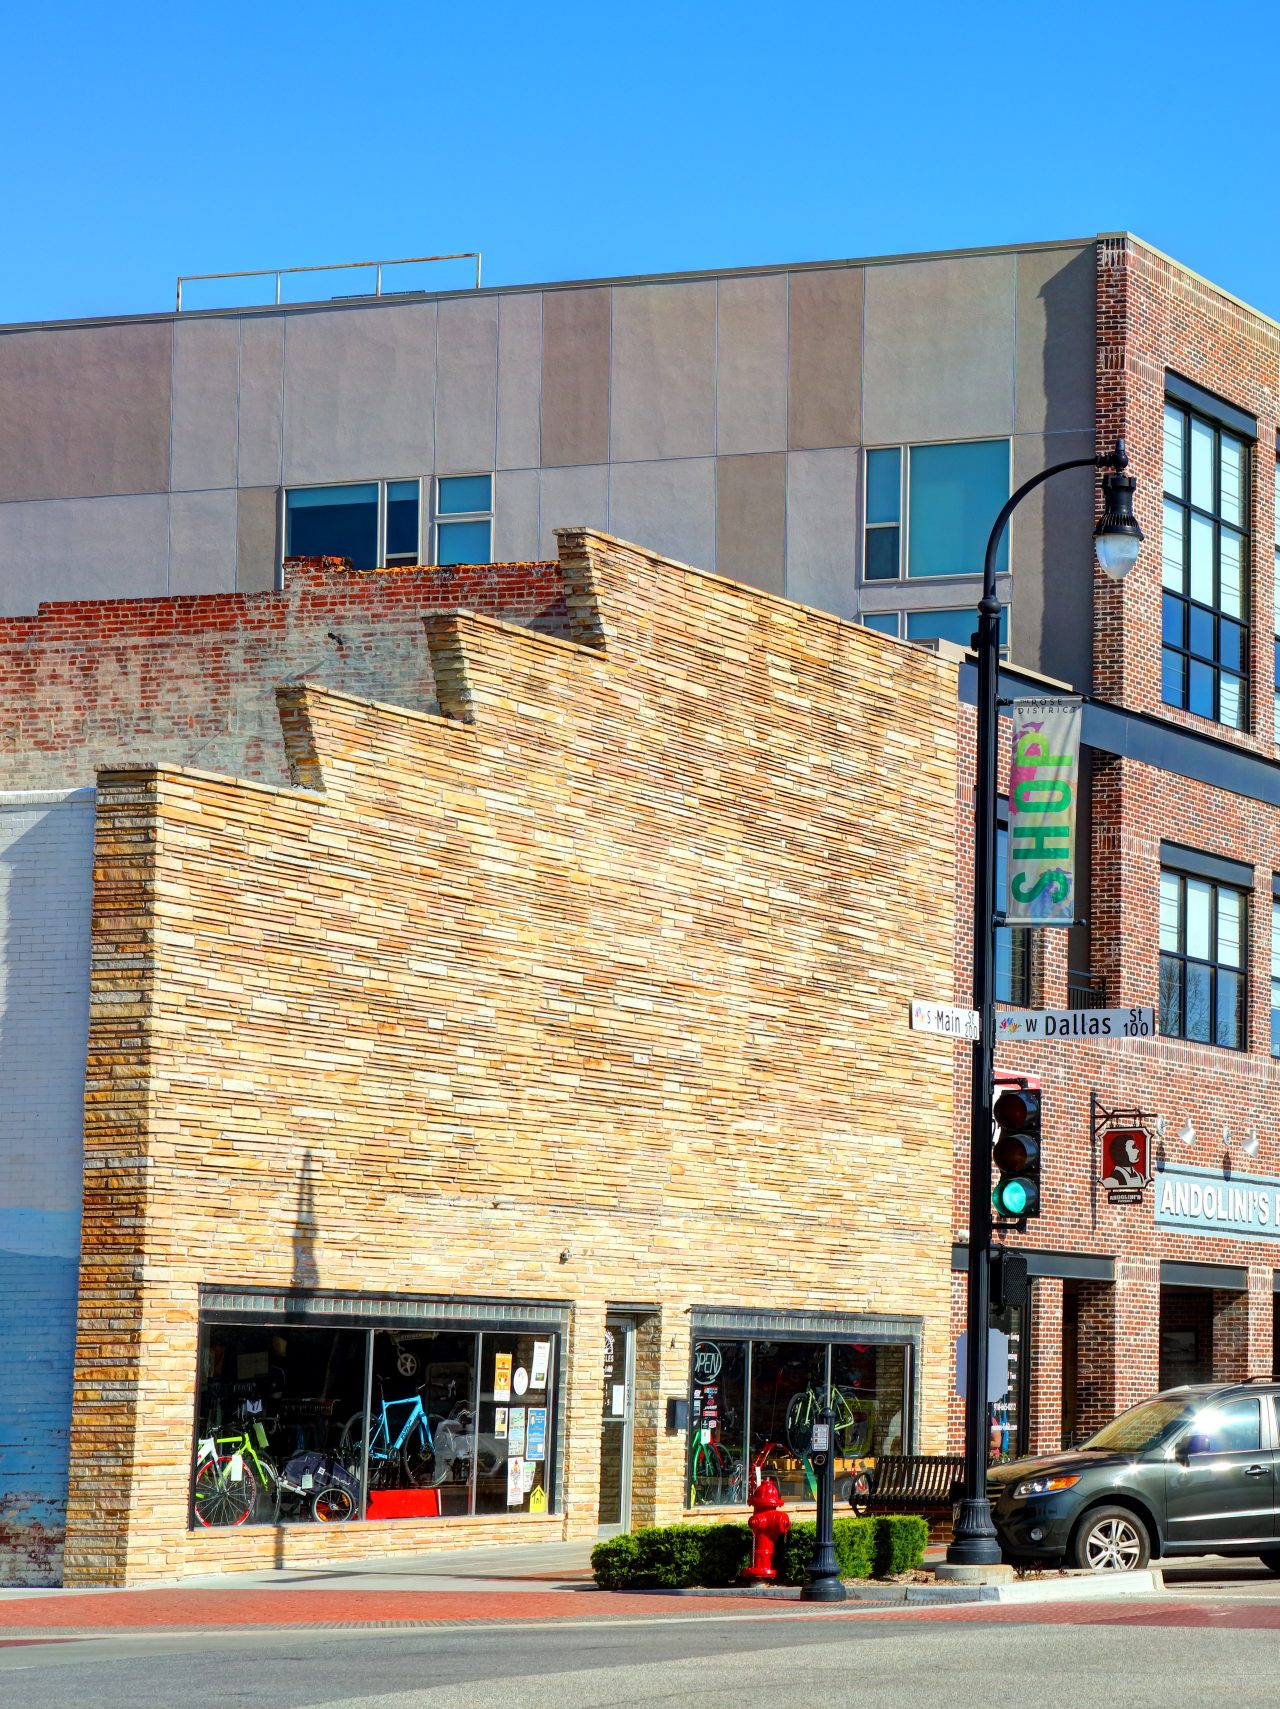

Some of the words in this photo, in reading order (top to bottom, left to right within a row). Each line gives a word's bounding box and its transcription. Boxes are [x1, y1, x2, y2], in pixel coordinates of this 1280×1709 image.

[1017, 706, 1078, 715] DISTRICT
[1031, 698, 1063, 708] ROSE
[1011, 732, 1073, 903] SHOP
[926, 1014, 931, 1025] S
[935, 1010, 961, 1034] Main
[967, 1011, 975, 1025] St
[964, 1024, 978, 1039] 200
[1025, 1018, 1038, 1033] W
[1044, 1013, 1112, 1036] Dallas
[1129, 1008, 1143, 1023] St
[1123, 1022, 1149, 1037] 100
[1160, 1180, 1270, 1226] ANDOLINI'S
